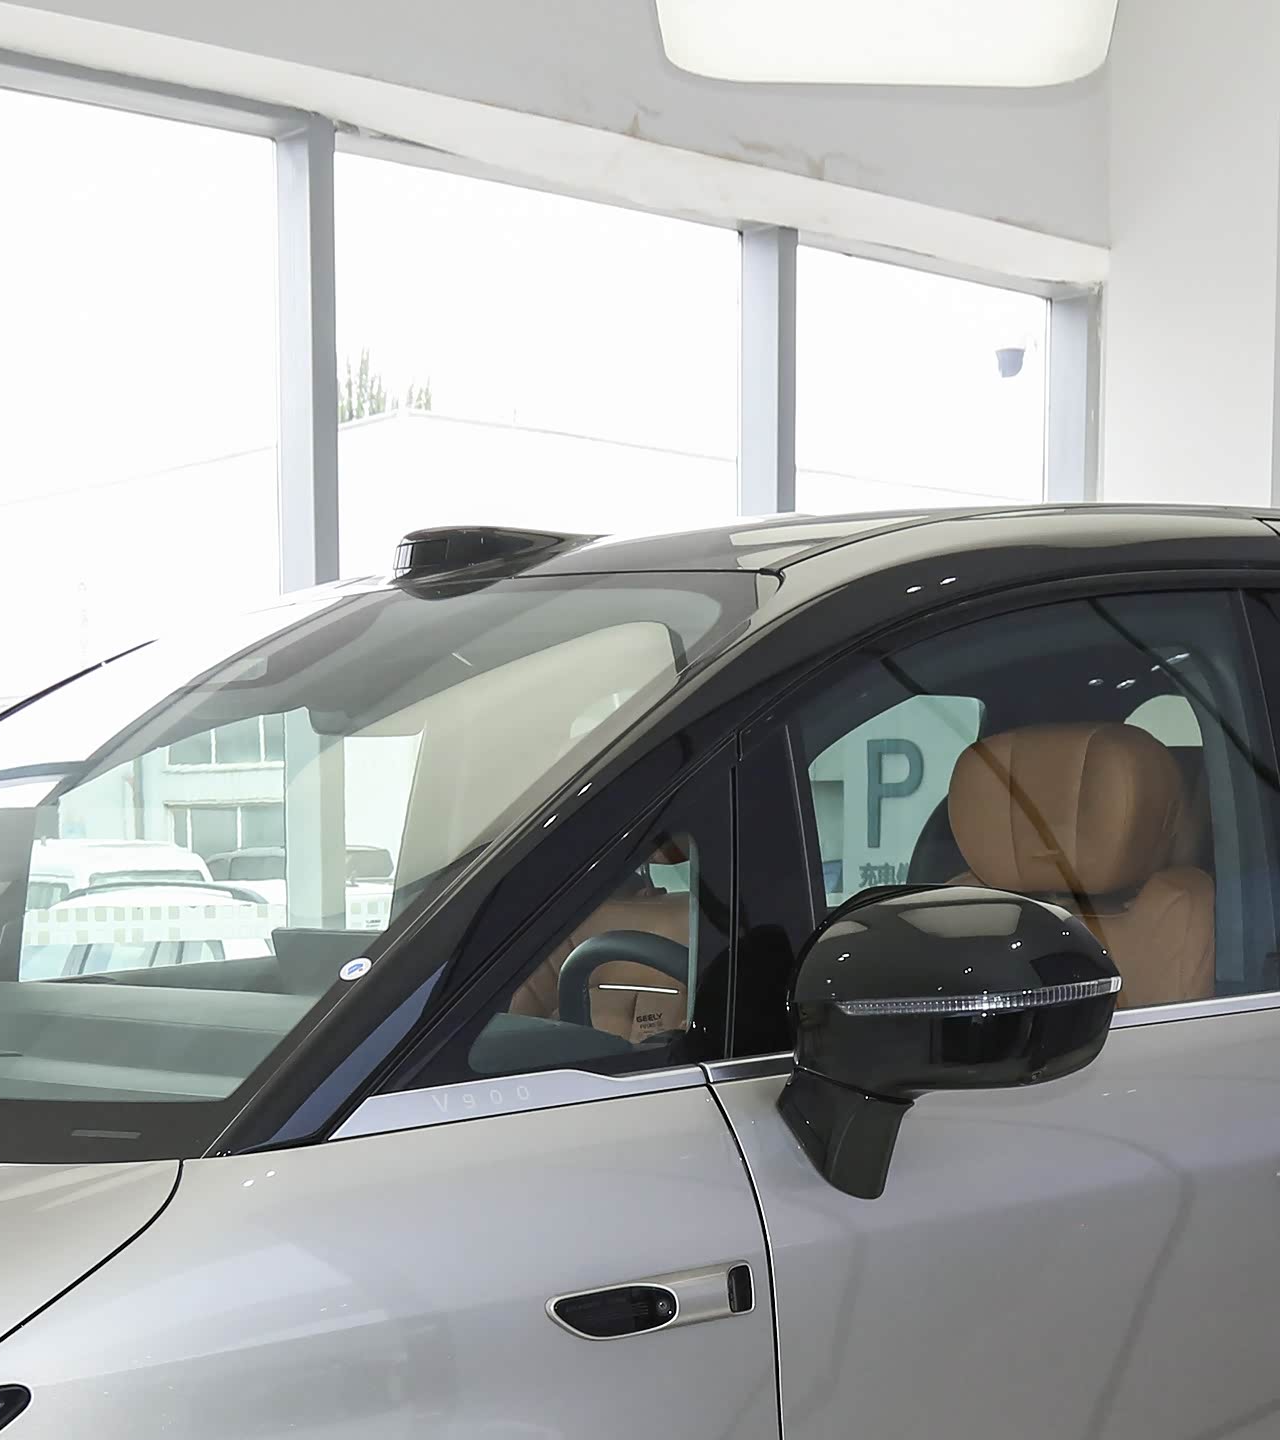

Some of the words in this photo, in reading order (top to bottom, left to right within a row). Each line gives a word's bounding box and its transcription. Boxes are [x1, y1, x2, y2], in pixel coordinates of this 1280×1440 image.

[867, 739, 925, 848] P
[636, 1012, 663, 1023] GEELY
[431, 1085, 530, 1113] V900
